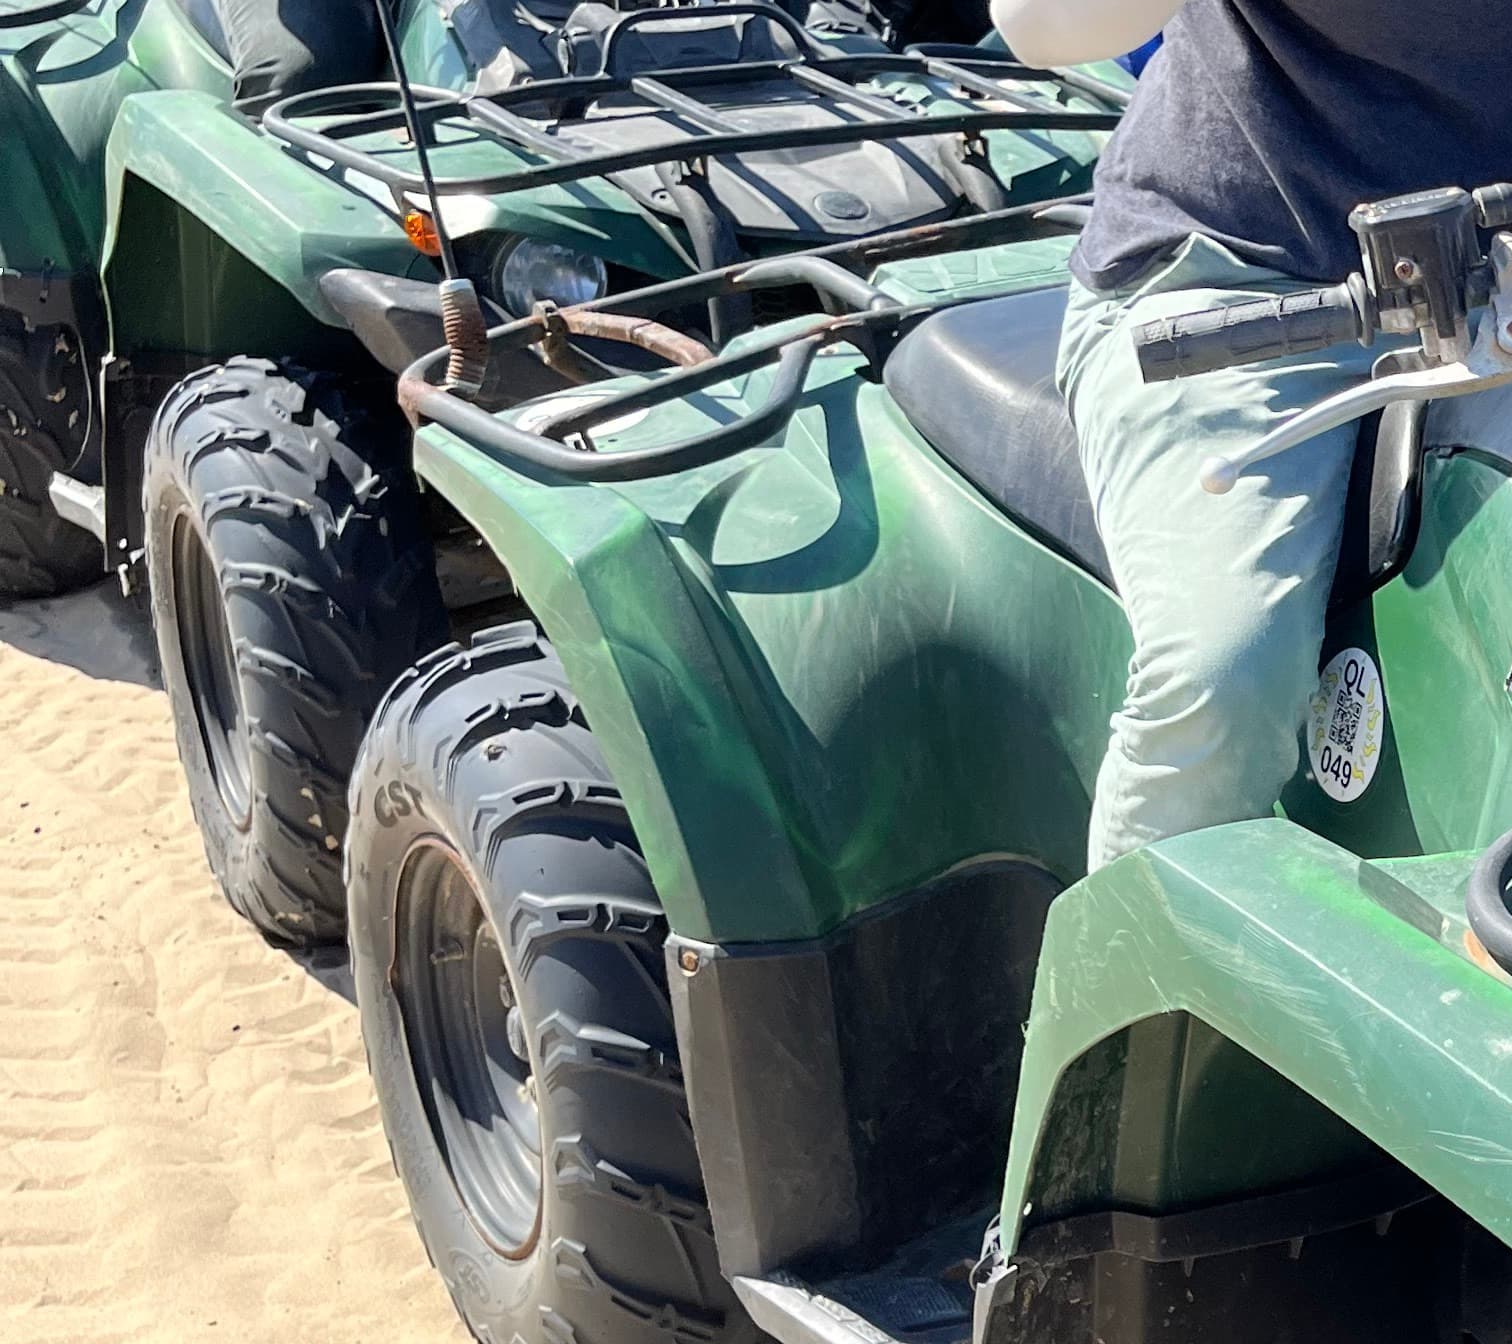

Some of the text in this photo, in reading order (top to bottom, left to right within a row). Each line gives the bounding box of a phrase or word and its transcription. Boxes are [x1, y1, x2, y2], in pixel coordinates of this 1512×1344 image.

[1344, 658, 1366, 698] QL
[1320, 745, 1353, 789] 049
[374, 779, 429, 828] CST
